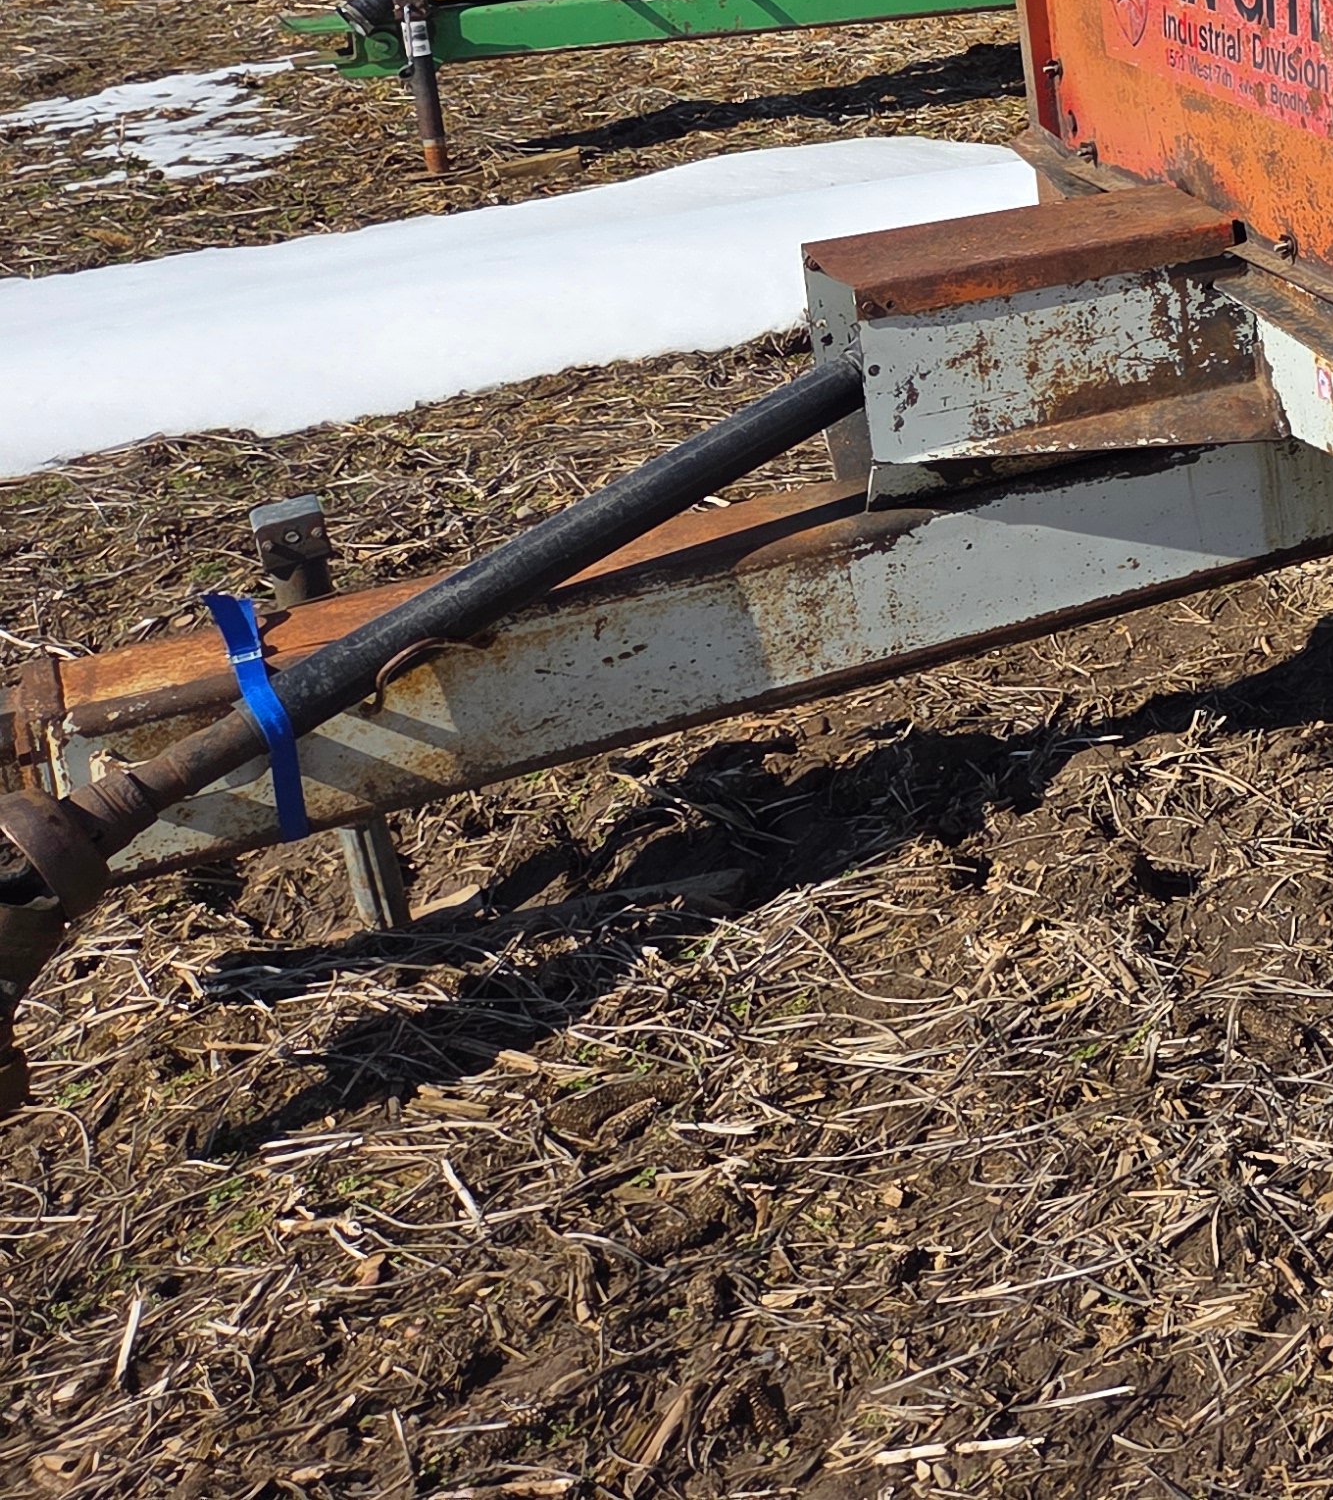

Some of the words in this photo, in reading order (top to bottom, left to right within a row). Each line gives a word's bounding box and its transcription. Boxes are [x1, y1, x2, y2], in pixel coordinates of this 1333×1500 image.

[1162, 7, 1242, 64] Industrial
[1252, 32, 1329, 93] Division
[1187, 54, 1213, 82] West
